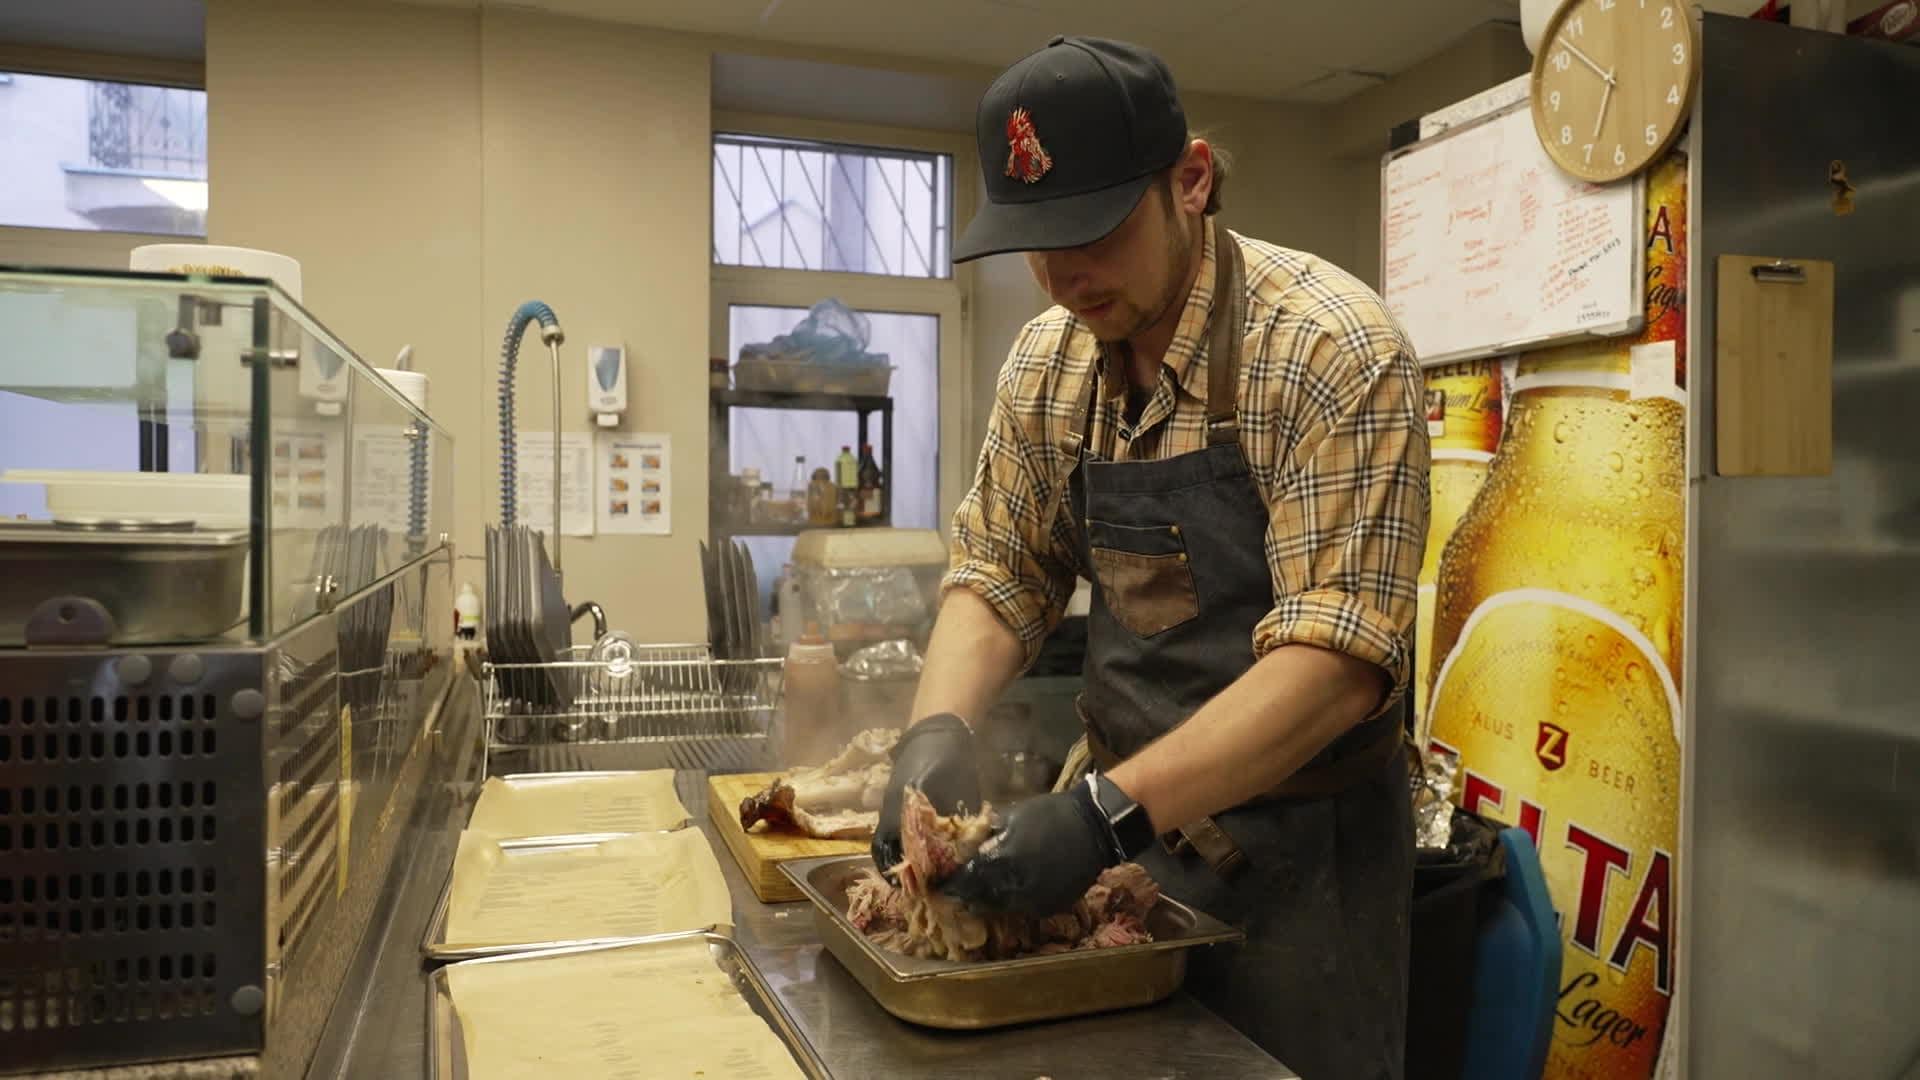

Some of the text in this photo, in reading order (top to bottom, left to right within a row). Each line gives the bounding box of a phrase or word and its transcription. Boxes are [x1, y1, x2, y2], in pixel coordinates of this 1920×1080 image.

[1660, 7, 1674, 29] 2
[1566, 19, 1585, 38] 11
[1552, 51, 1571, 72] 10
[1672, 44, 1685, 65] 3
[1550, 91, 1561, 111] 9
[1666, 85, 1681, 105] 4
[1561, 127, 1573, 145] 8
[1645, 125, 1658, 145] 5
[1583, 144, 1594, 164] 7
[1613, 145, 1626, 165] 6
[1472, 711, 1514, 741] ALUS
[1590, 759, 1635, 794] BEER
[1554, 971, 1645, 1048] Lager
